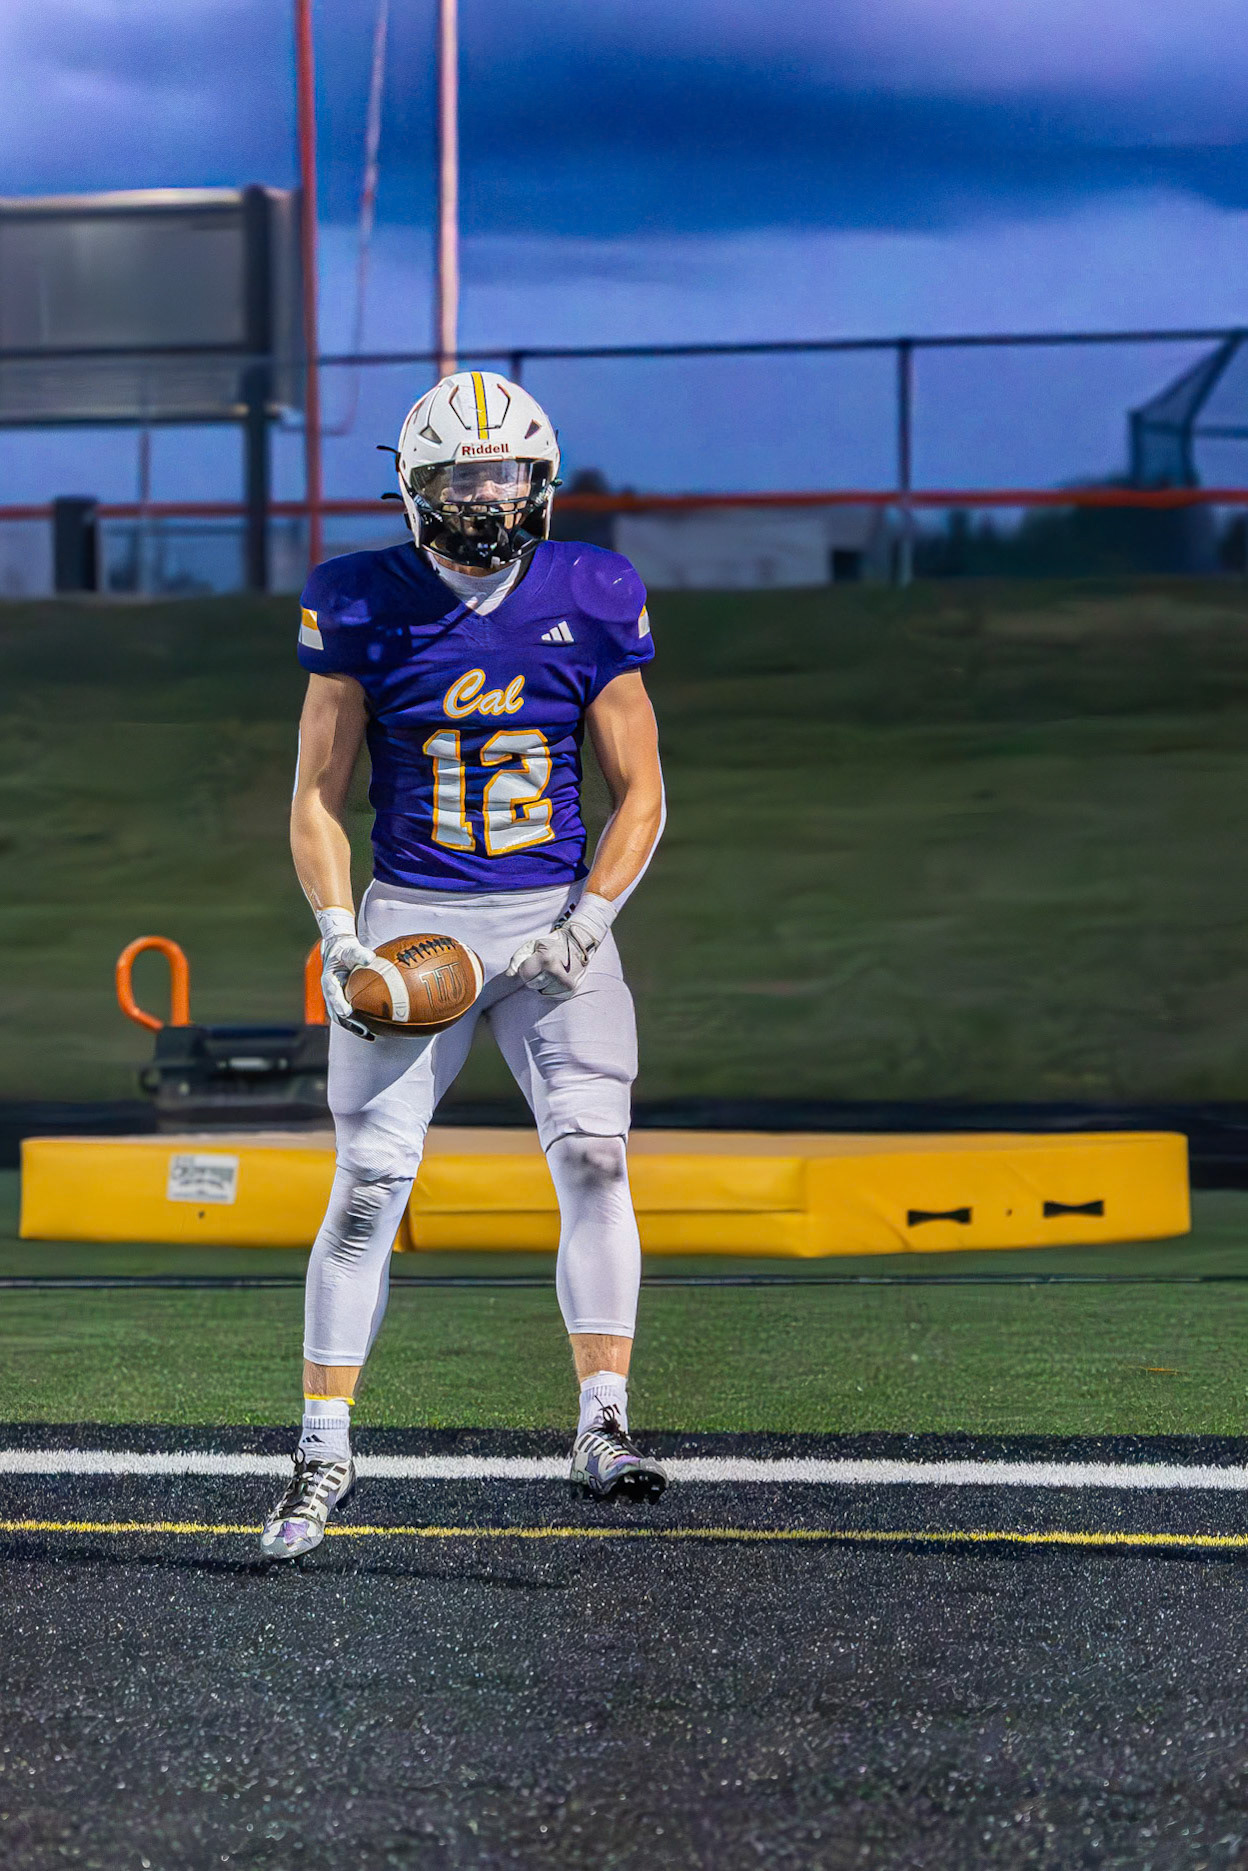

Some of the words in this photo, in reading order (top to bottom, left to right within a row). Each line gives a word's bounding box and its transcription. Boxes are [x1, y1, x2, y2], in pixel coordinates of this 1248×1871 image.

[461, 443, 509, 456] Riddell
[443, 668, 525, 719] Cal
[423, 729, 555, 856] 12
